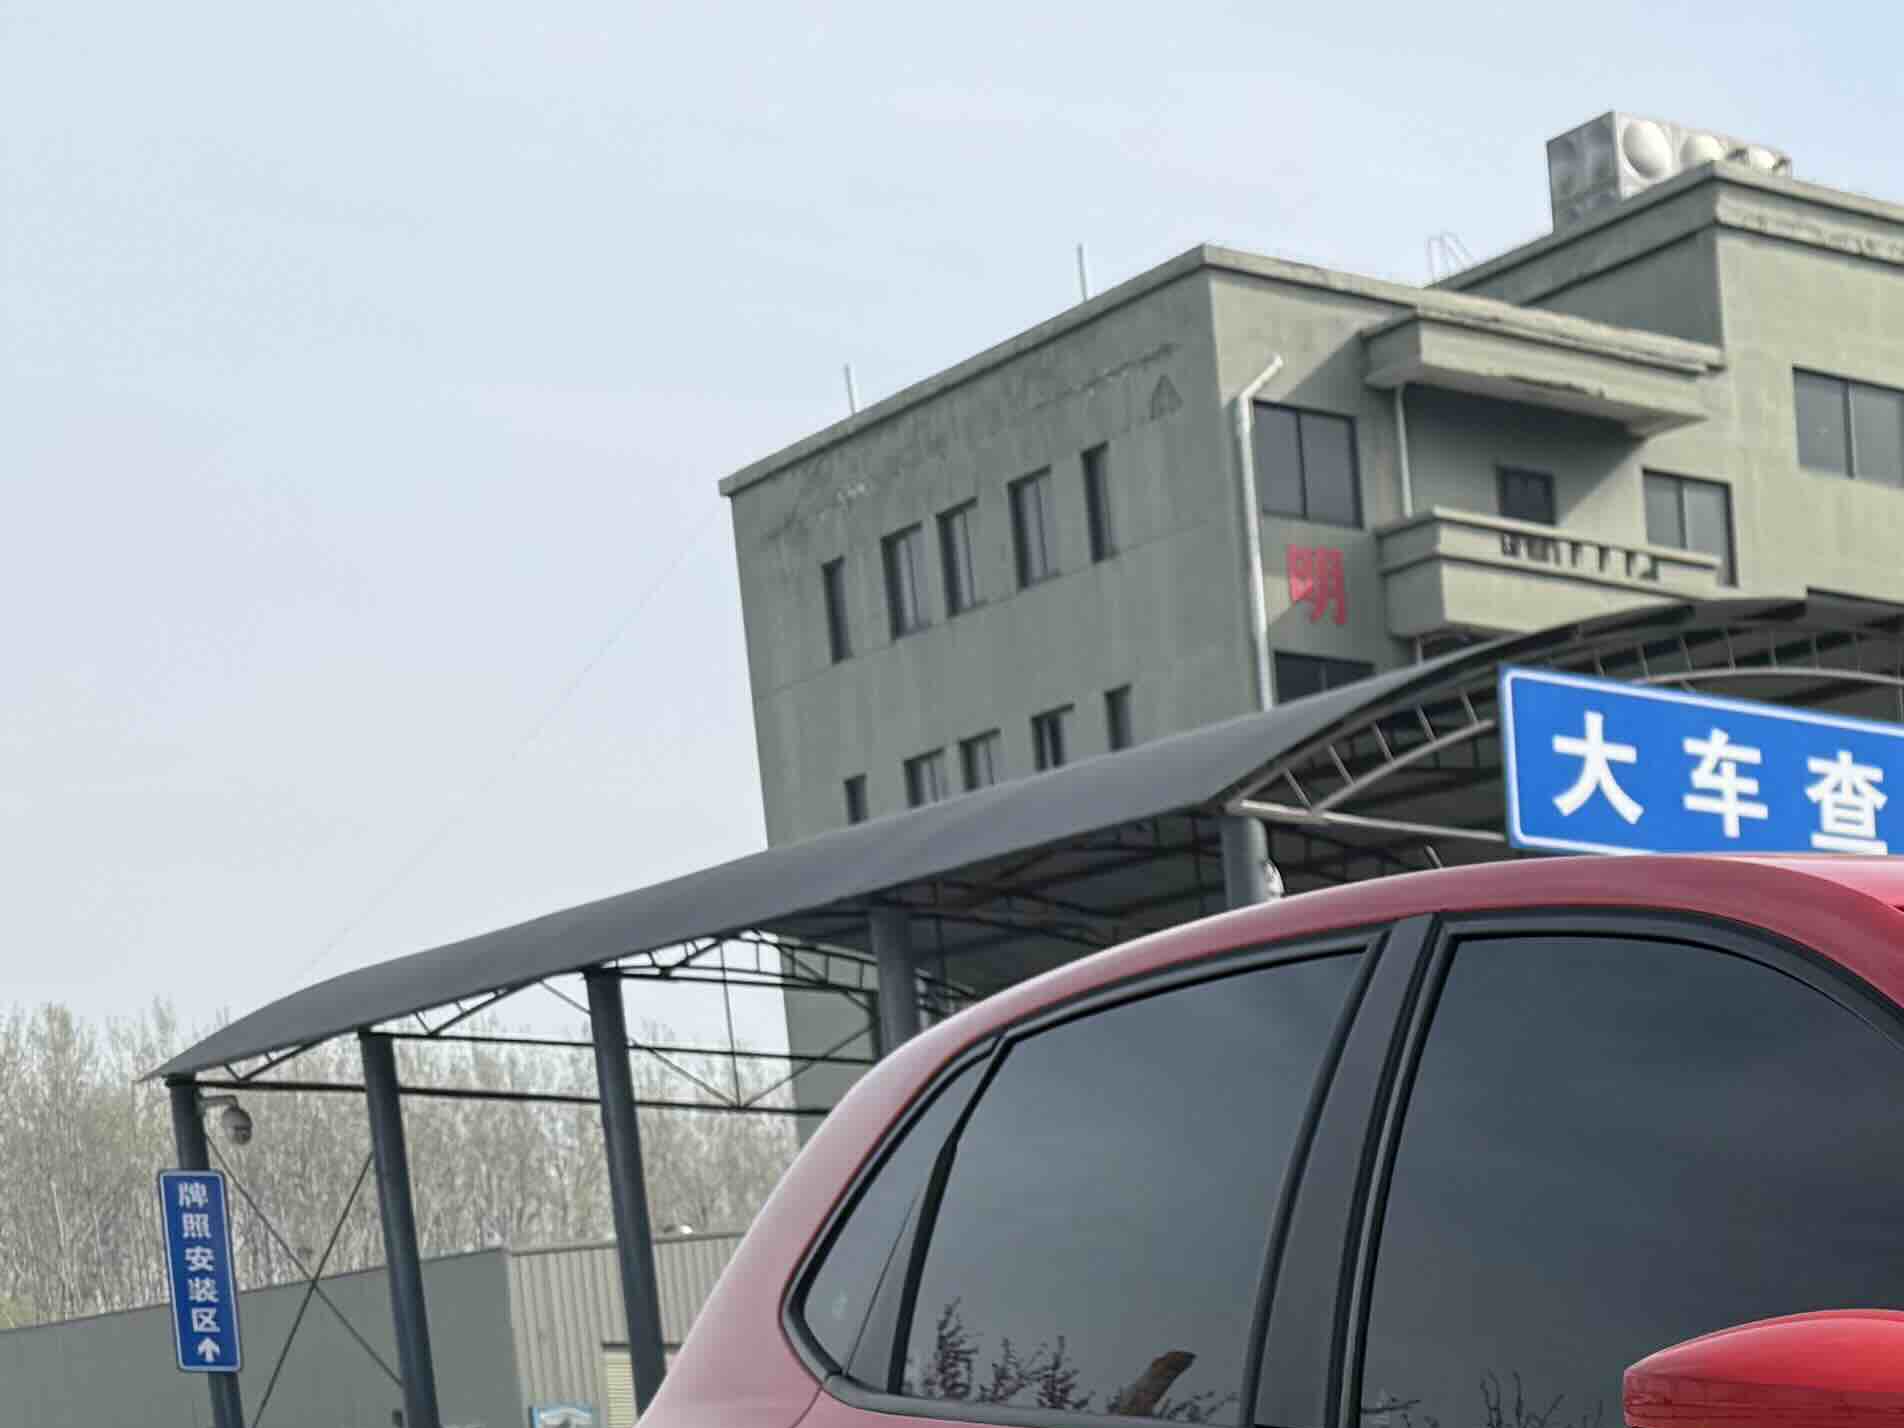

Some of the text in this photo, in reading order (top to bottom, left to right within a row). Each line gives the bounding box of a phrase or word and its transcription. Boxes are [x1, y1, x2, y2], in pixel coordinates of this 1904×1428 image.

[178, 1181, 222, 1333] 牌照安装区
